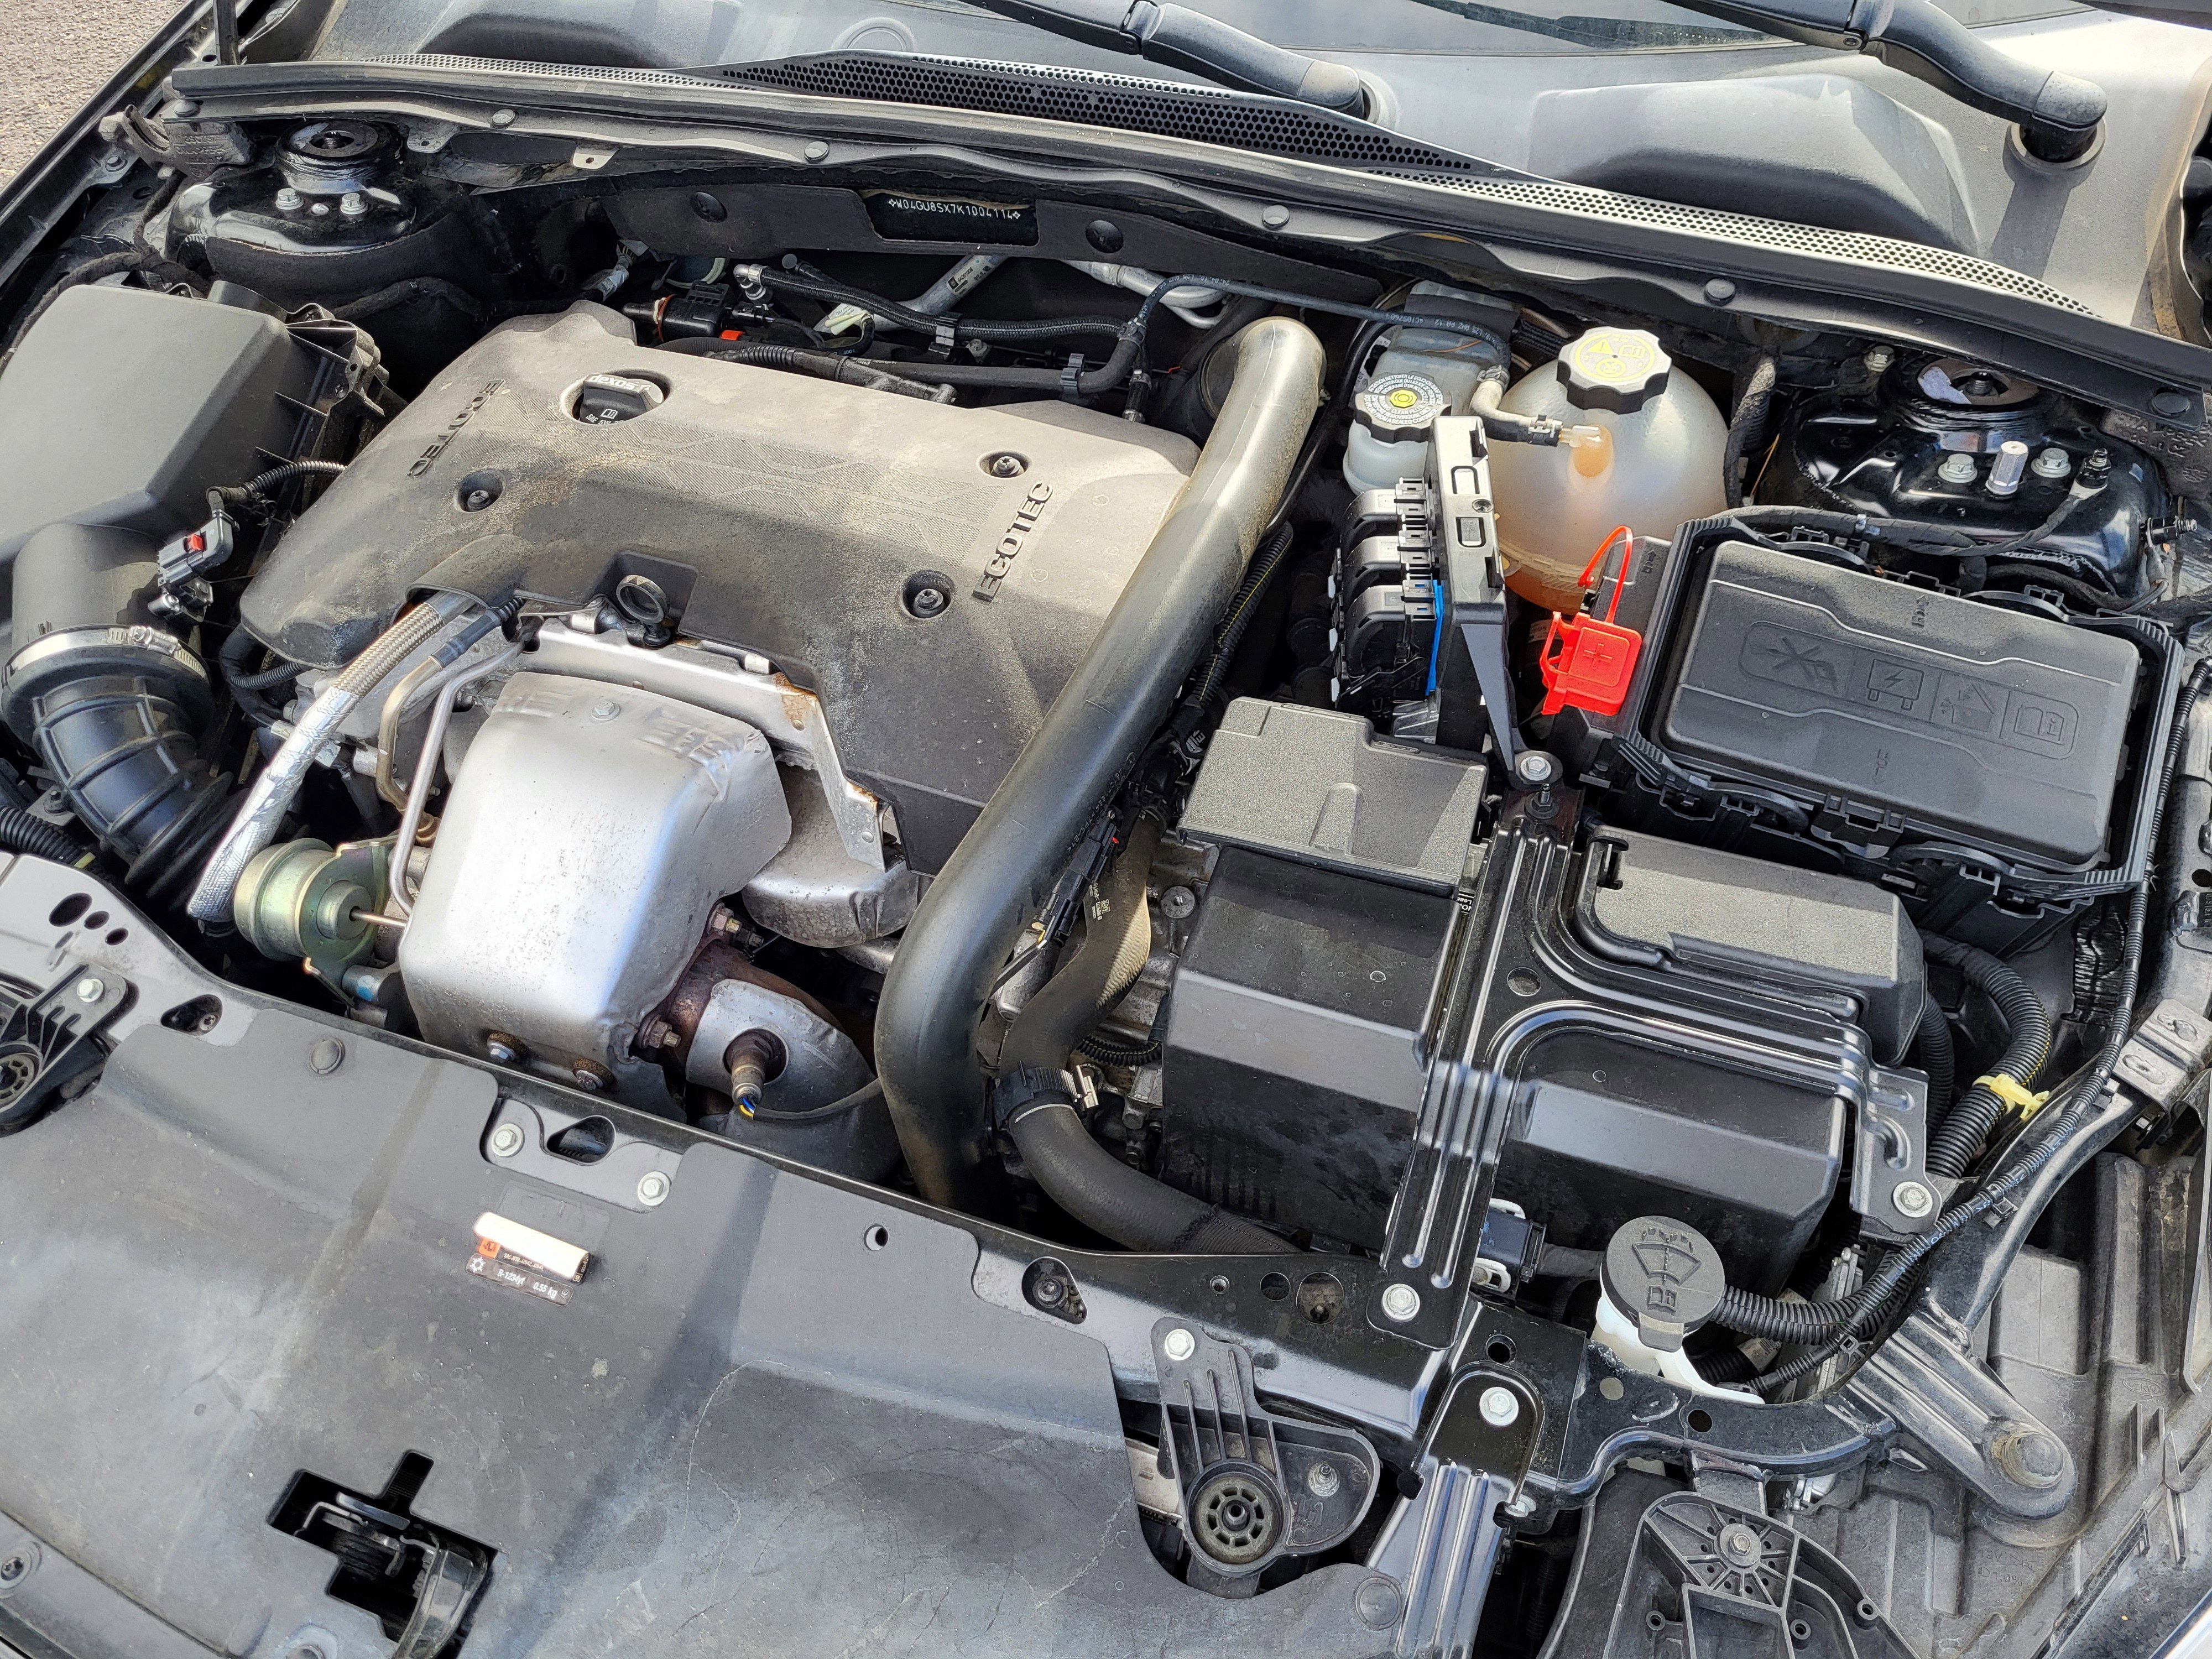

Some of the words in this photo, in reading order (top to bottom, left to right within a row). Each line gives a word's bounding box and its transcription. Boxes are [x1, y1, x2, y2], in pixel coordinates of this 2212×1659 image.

[588, 374, 635, 391] dexos
[586, 414, 599, 423] SAE
[972, 480, 1053, 606] ECOTEC
[497, 1269, 526, 1285] R-1234yf
[533, 1282, 548, 1293] 0.55
[547, 1286, 557, 1300] kg
